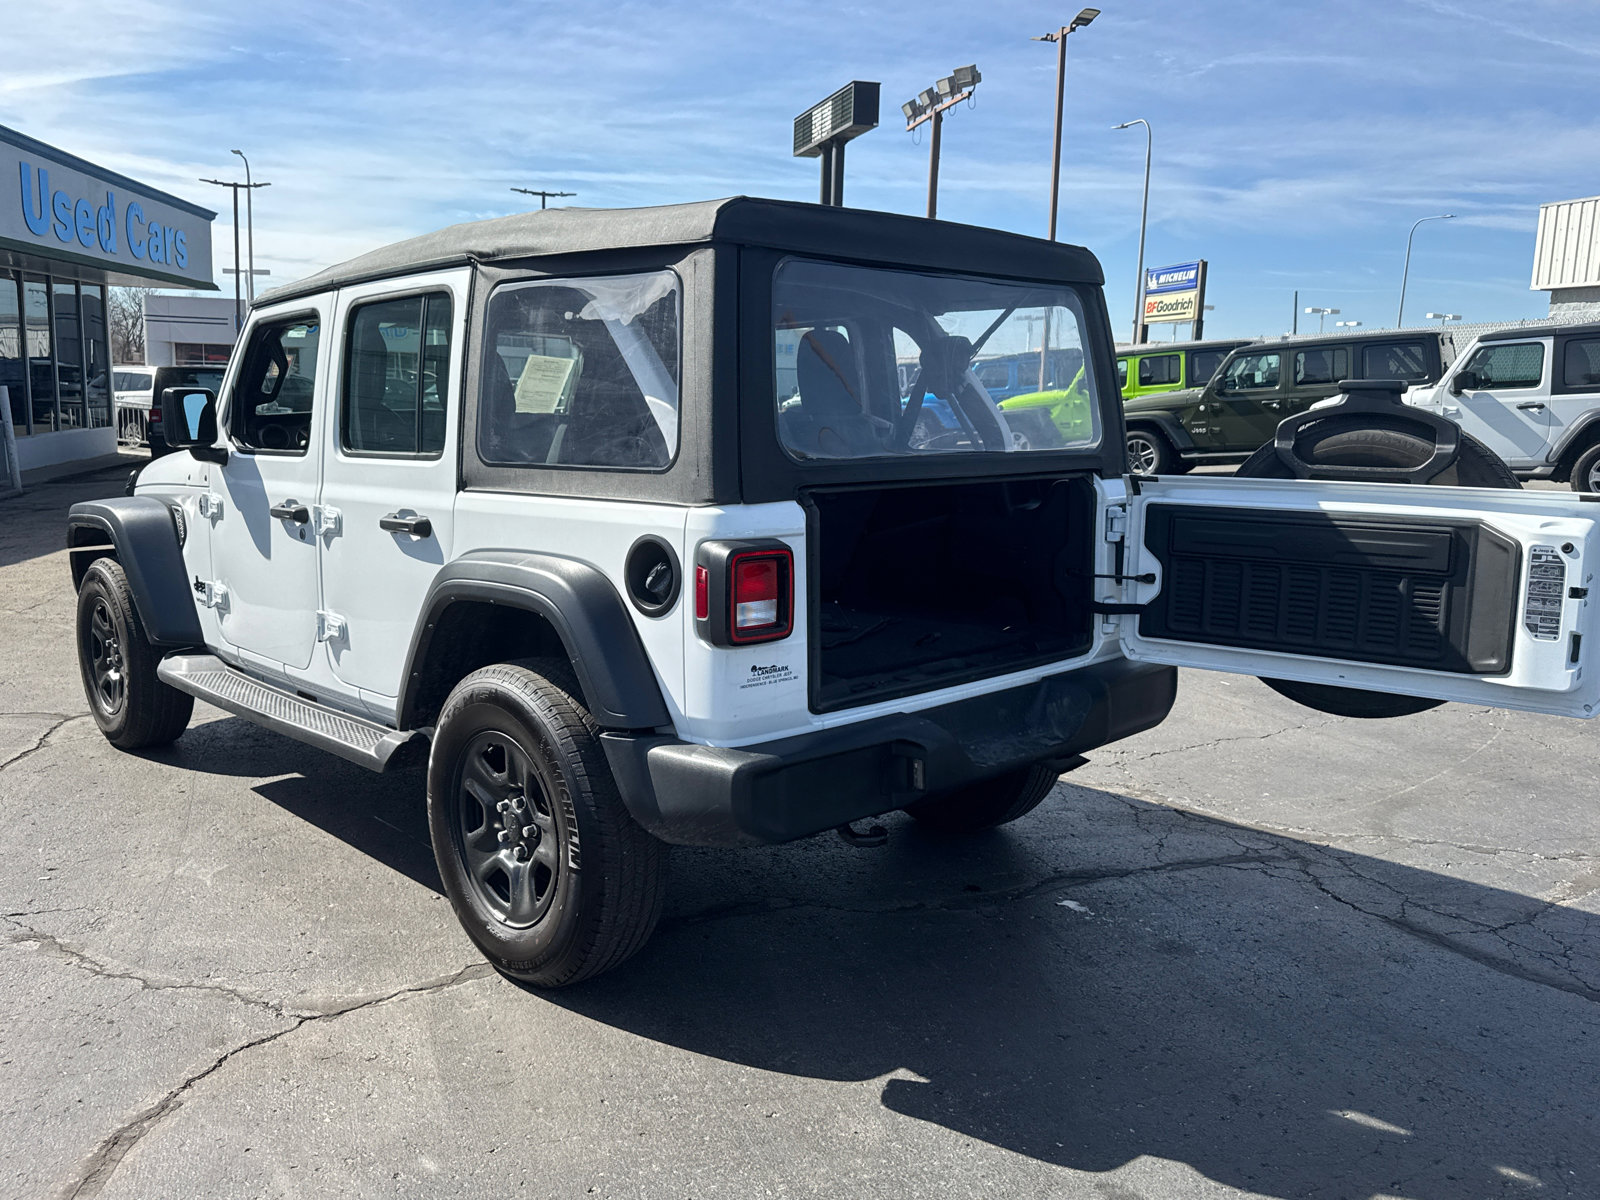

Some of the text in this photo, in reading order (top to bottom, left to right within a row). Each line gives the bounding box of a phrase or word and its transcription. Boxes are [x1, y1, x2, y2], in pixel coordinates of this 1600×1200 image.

[19, 161, 189, 269] Used Cars
[1158, 270, 1197, 284] MICHELIN
[1146, 298, 1193, 313] BFGoodrich
[757, 665, 789, 676] LANDMARK
[550, 760, 581, 870] MICHELIN
